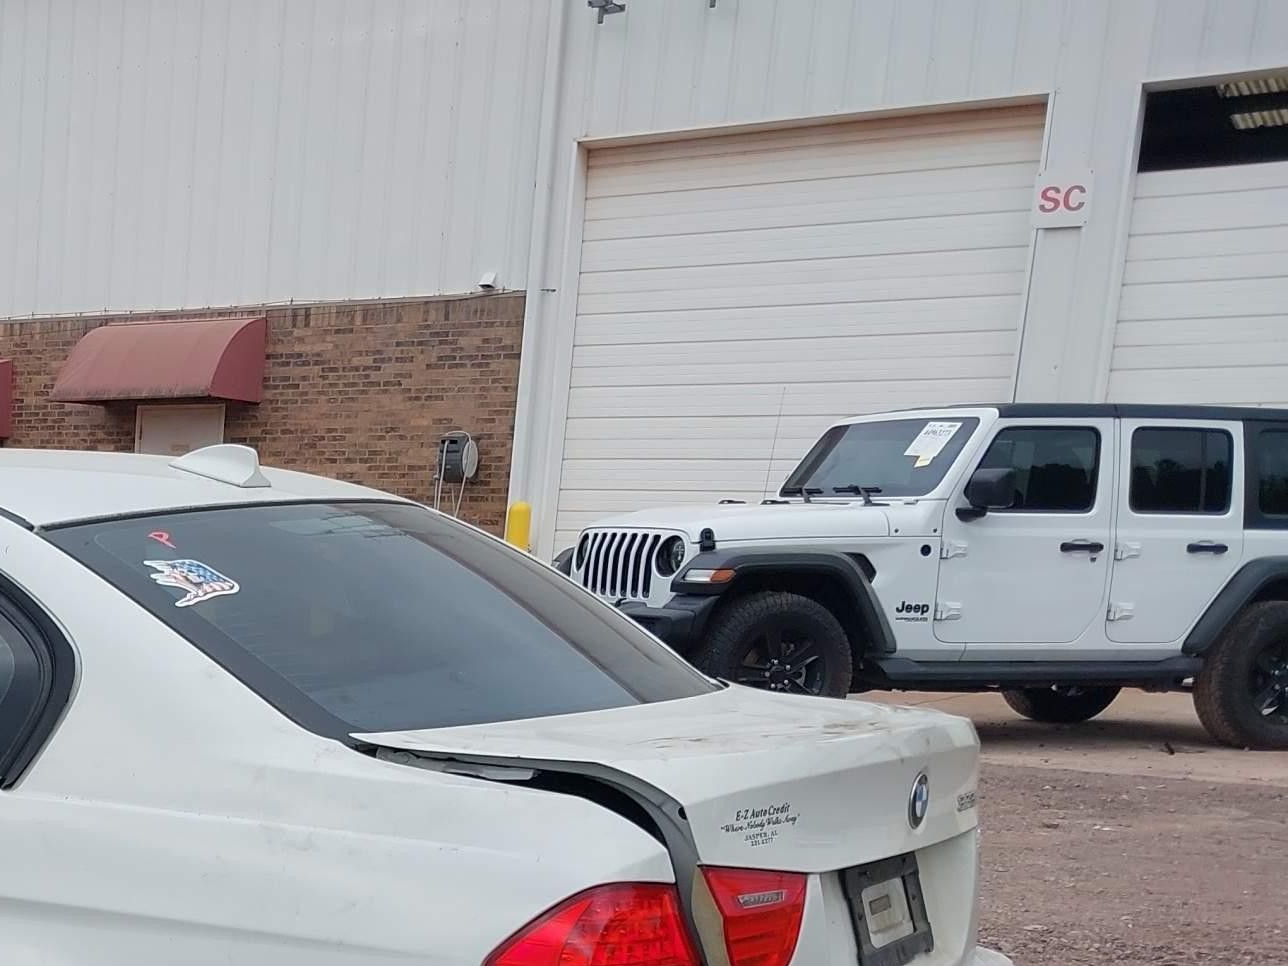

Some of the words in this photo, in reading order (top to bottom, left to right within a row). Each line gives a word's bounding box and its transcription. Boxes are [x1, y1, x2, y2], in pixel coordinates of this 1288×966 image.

[1039, 185, 1087, 214] SC
[895, 600, 930, 616] Jeep
[735, 809, 750, 822] E-Z
[750, 808, 768, 820] Auto
[768, 802, 791, 816] Credit
